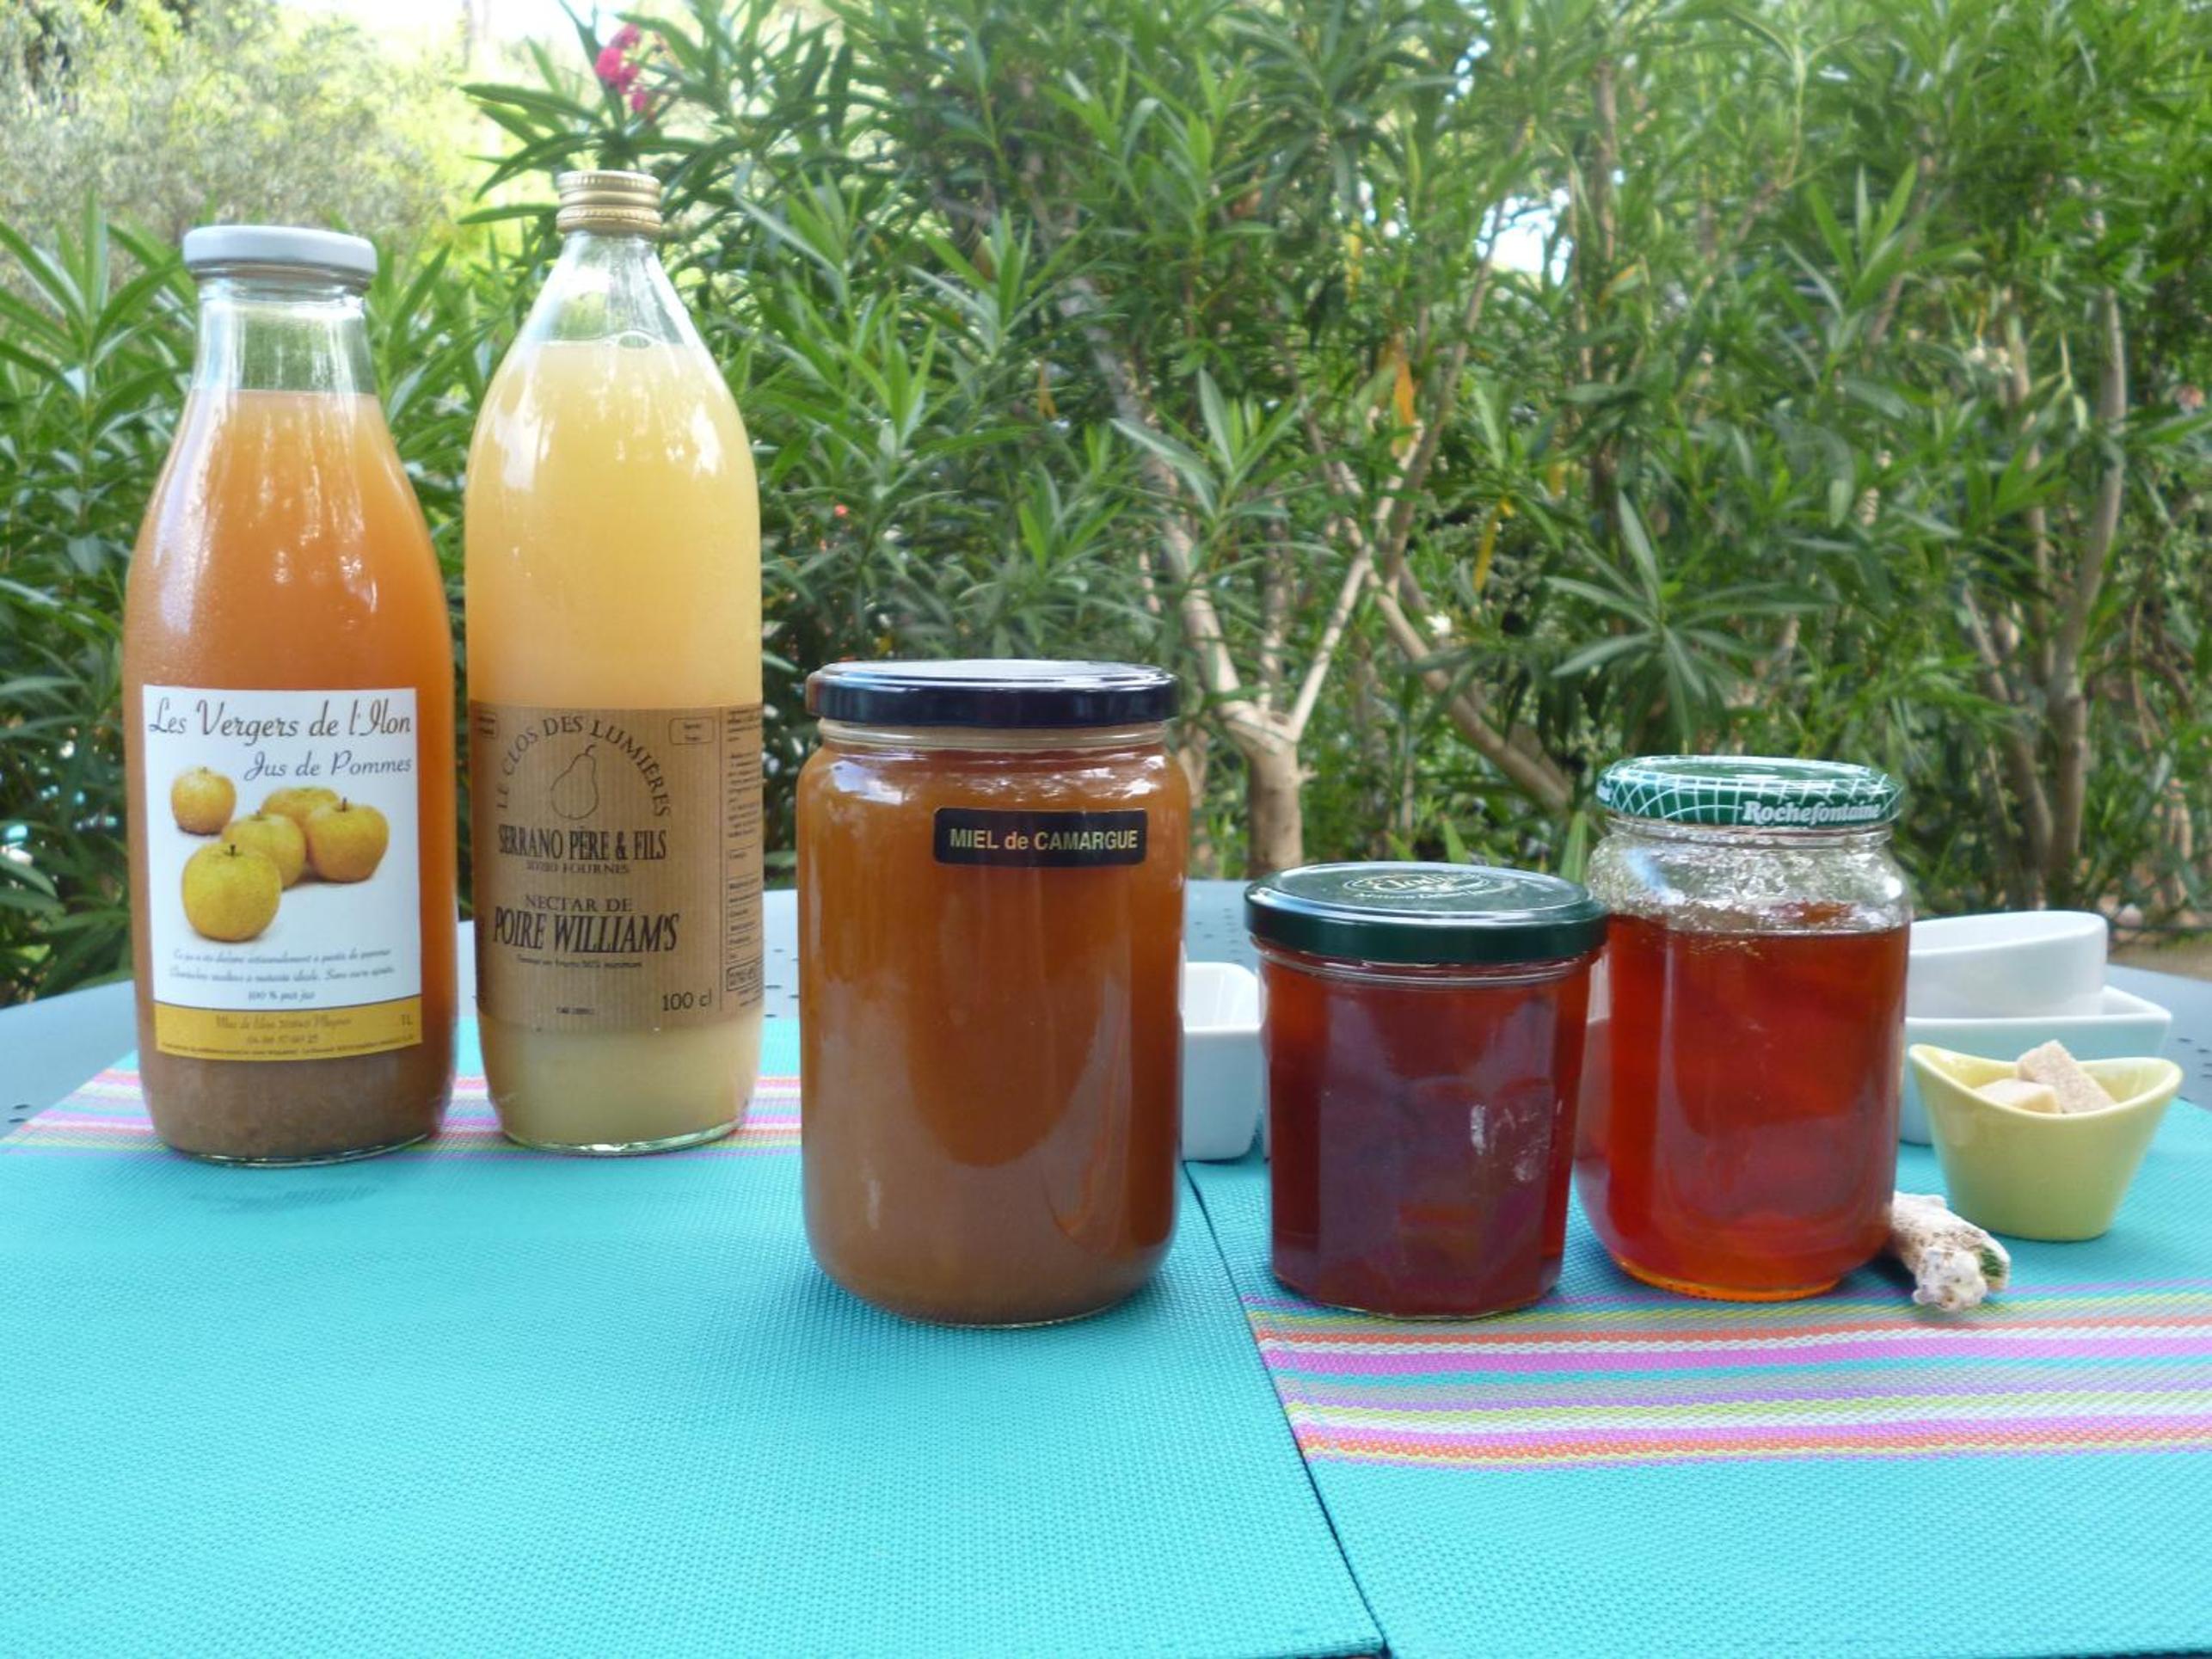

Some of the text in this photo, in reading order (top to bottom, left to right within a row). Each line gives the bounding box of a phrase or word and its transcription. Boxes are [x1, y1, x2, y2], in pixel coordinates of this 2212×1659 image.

[149, 697, 187, 734] Les
[196, 699, 299, 746] Vergers
[309, 699, 339, 737] de
[501, 727, 539, 776] CLOS
[543, 716, 584, 737] DES
[244, 750, 412, 781] Jus de Pommes
[1742, 800, 1882, 826] Rochefontaine
[498, 823, 563, 860] SERRANO
[615, 830, 629, 861] &
[633, 829, 667, 861] FILS
[949, 828, 1138, 851] MIEL de CAMARGUE
[525, 894, 633, 912] NECTAR DE
[493, 906, 548, 949] POIRE
[553, 912, 680, 954] WILLIAM'S
[662, 992, 695, 1011] 100
